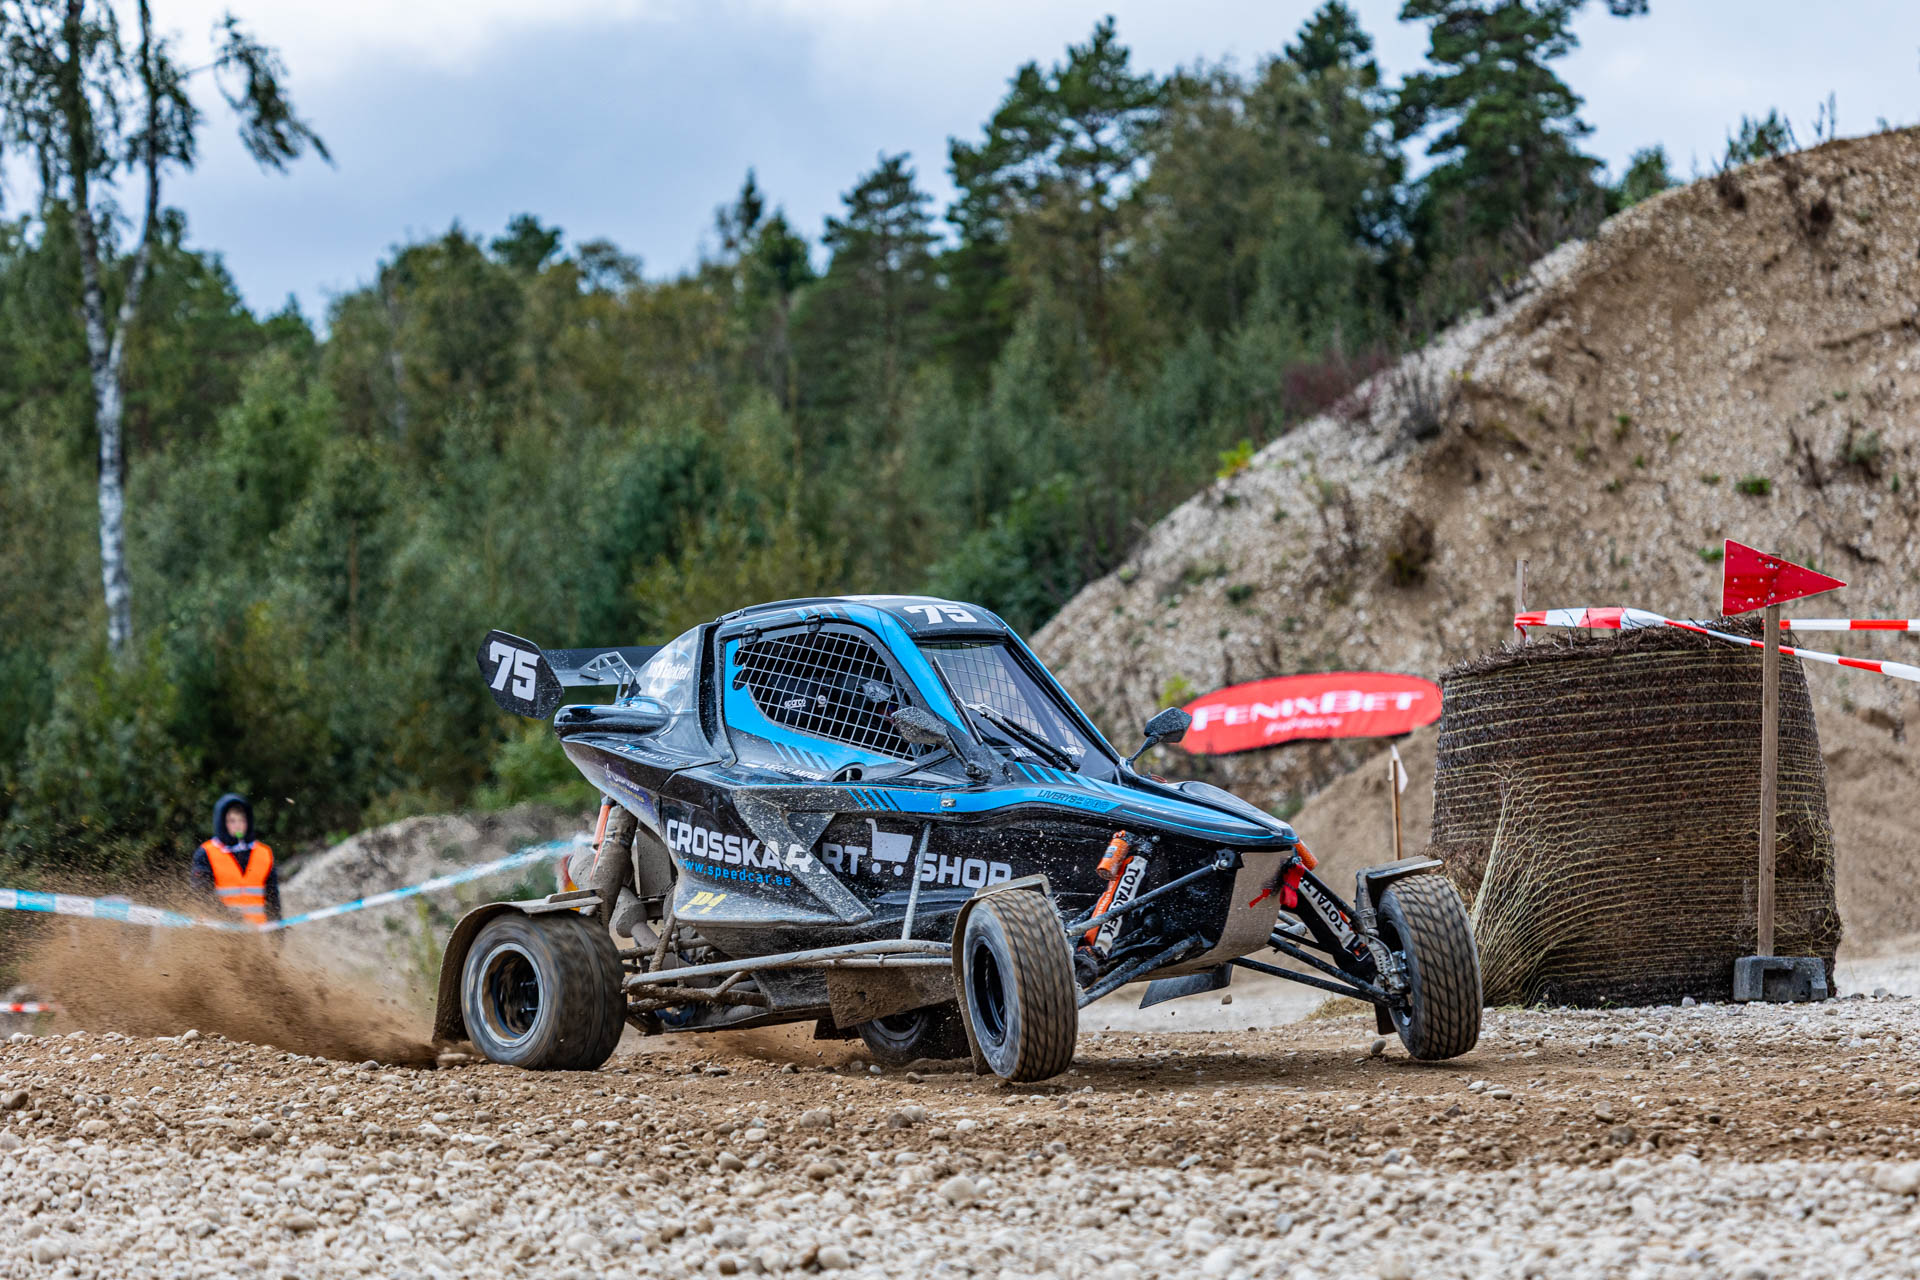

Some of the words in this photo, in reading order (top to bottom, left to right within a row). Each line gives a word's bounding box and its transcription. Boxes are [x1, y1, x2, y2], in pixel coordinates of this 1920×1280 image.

[903, 604, 978, 625] 75
[489, 640, 541, 702] 75
[914, 852, 1012, 889] SHOP
